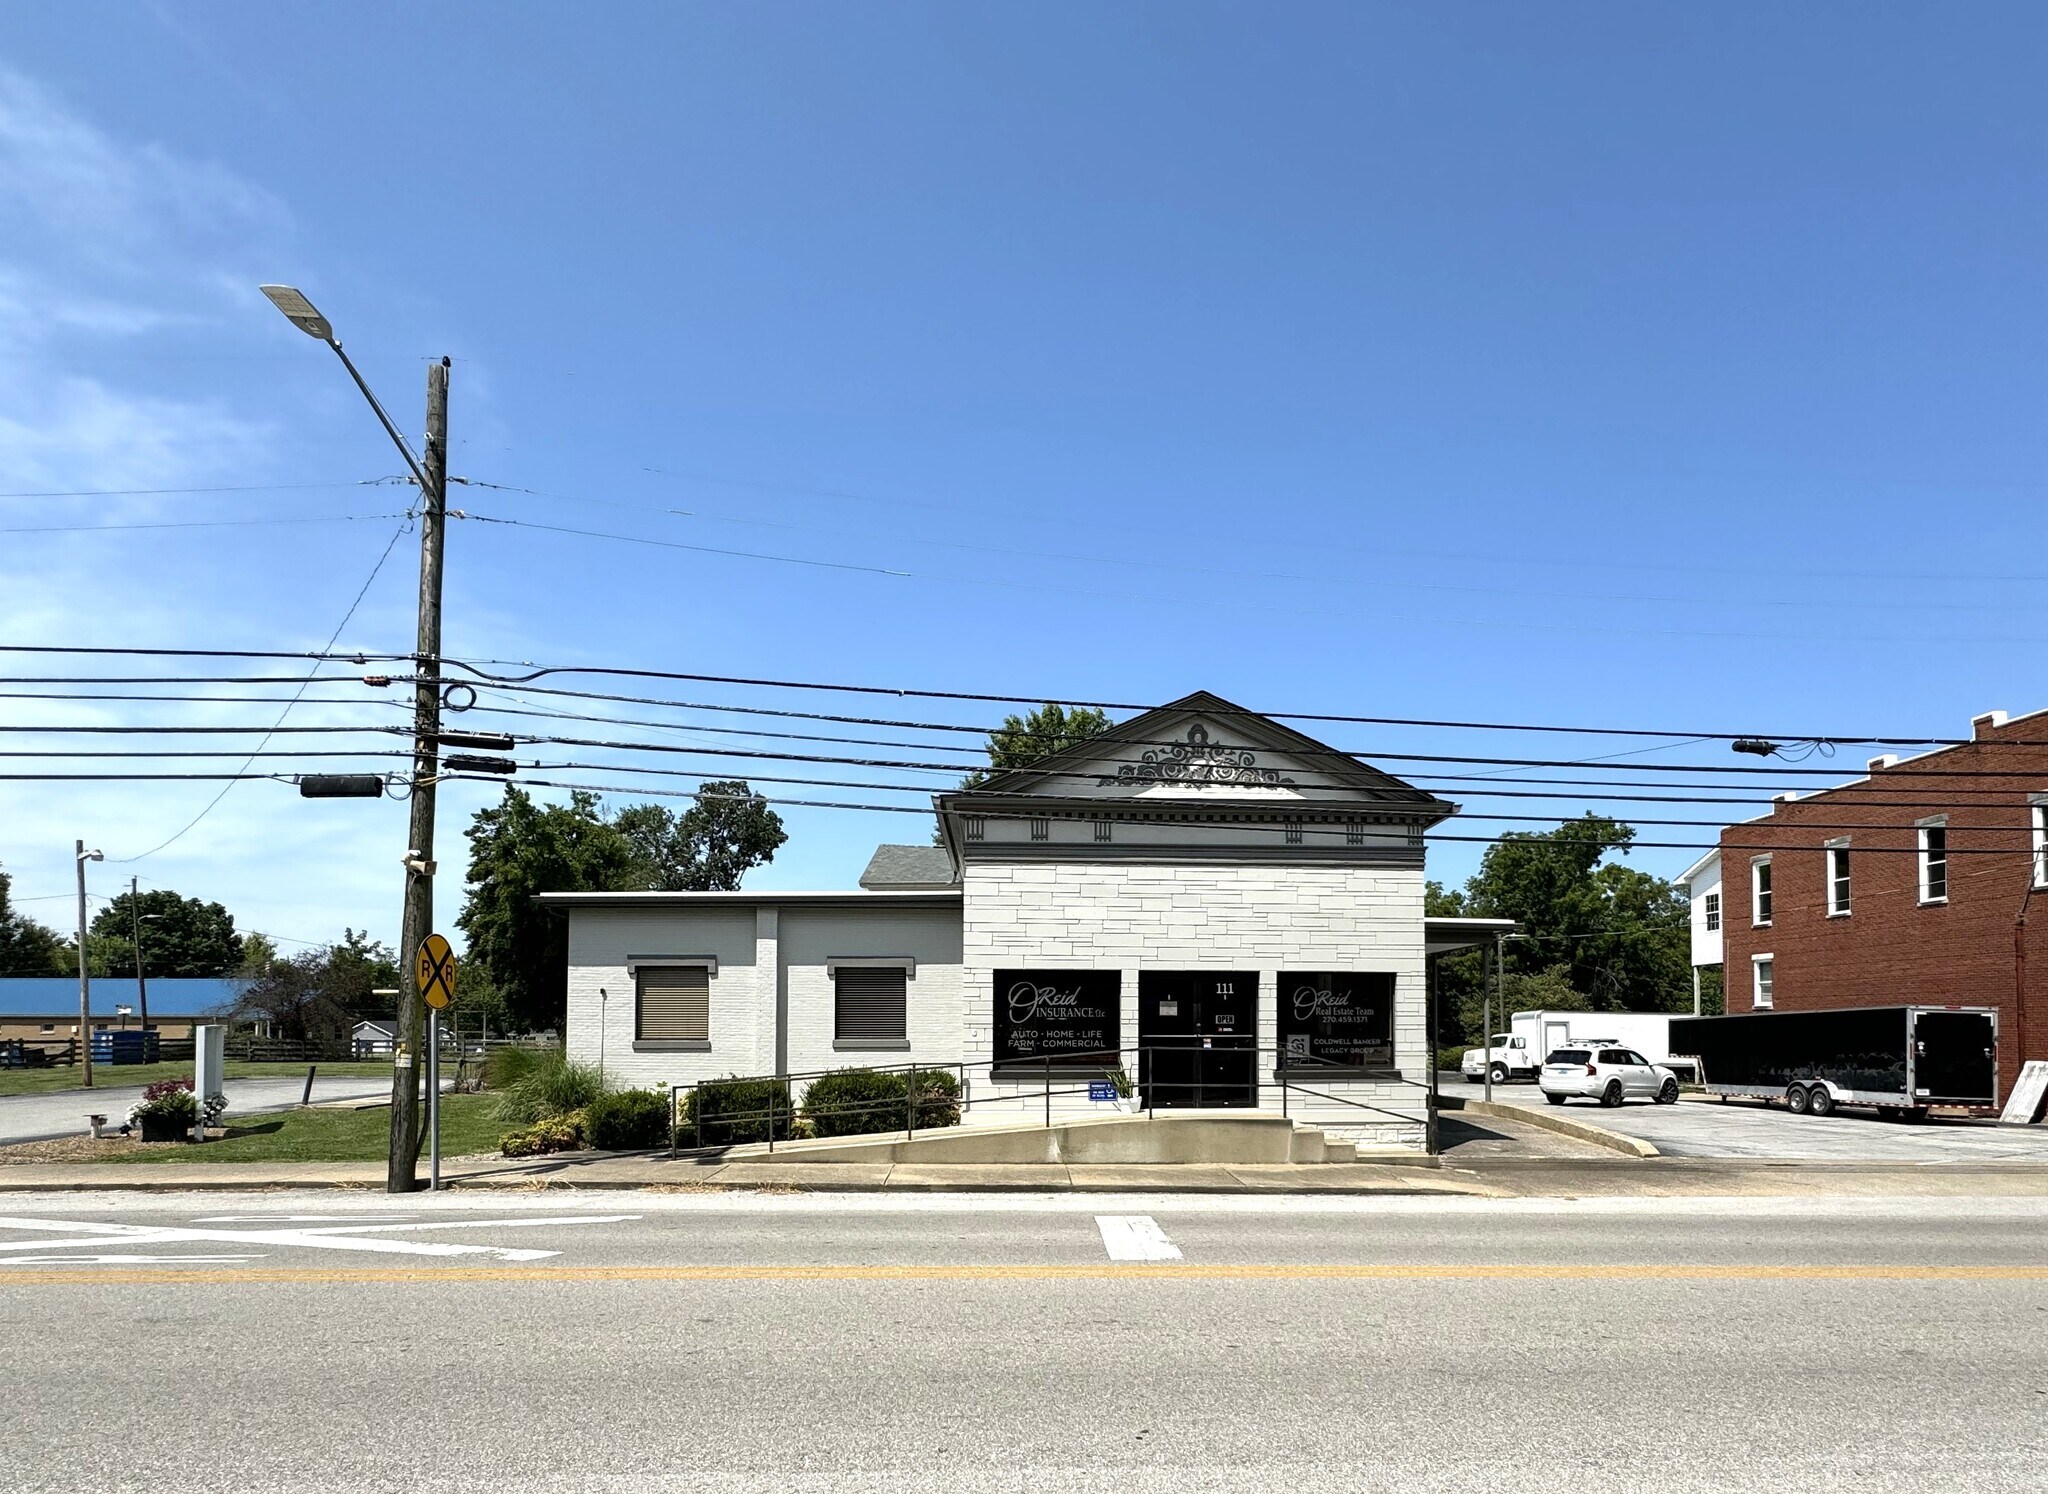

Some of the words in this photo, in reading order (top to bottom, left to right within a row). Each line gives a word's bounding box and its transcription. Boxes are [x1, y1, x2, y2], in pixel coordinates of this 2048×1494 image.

[422, 959, 431, 978] R
[445, 964, 453, 982] R
[1216, 983, 1234, 994] 111
[1036, 1007, 1094, 1018] INSURANCE
[1316, 1007, 1332, 1015] Real
[1333, 1007, 1354, 1015] Estate
[1355, 1007, 1374, 1015] Team
[1217, 1015, 1233, 1023] OPEN
[1012, 1030, 1039, 1038] AUTO
[1046, 1030, 1074, 1038] HOME
[1082, 1030, 1102, 1038] LIFE
[1008, 1040, 1035, 1048] FARM
[1042, 1040, 1106, 1048] COMMERCIAL
